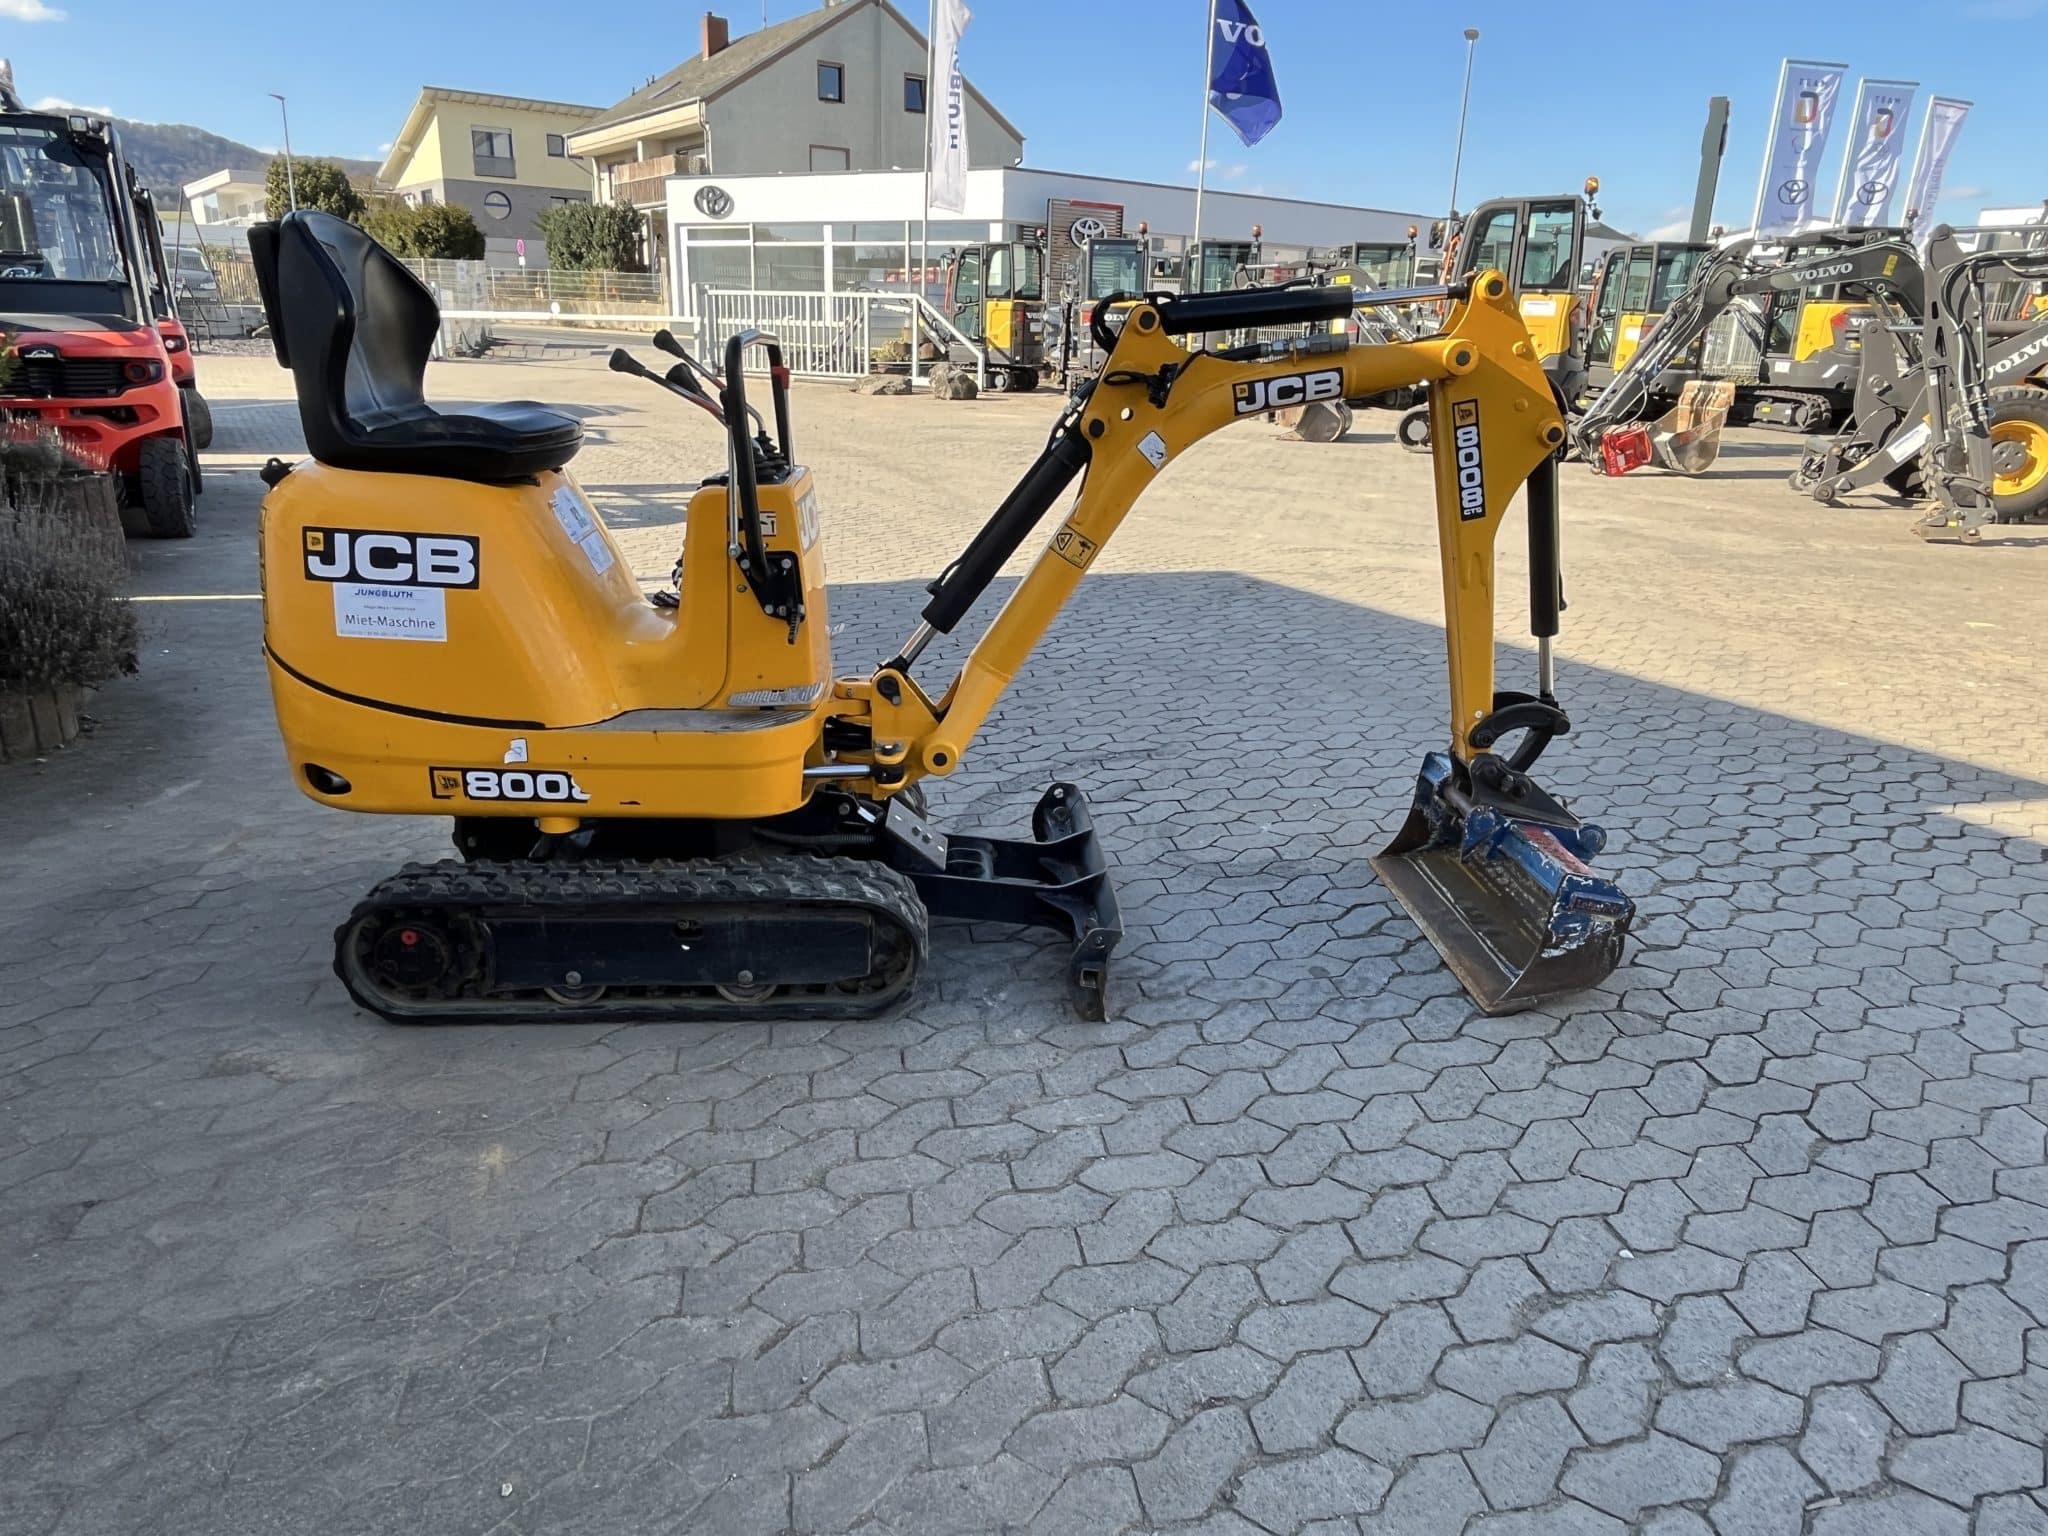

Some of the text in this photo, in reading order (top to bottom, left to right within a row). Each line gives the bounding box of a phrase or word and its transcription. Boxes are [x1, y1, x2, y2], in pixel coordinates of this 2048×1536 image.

[1875, 96, 1902, 105] TEAM
[1791, 262, 1854, 282] VOLVO
[1237, 371, 1342, 413] JCB
[1457, 425, 1483, 508] 8008
[307, 533, 476, 584] JCB
[354, 588, 414, 599] JUNGBLUTH
[345, 614, 436, 630] Miet-Maschine
